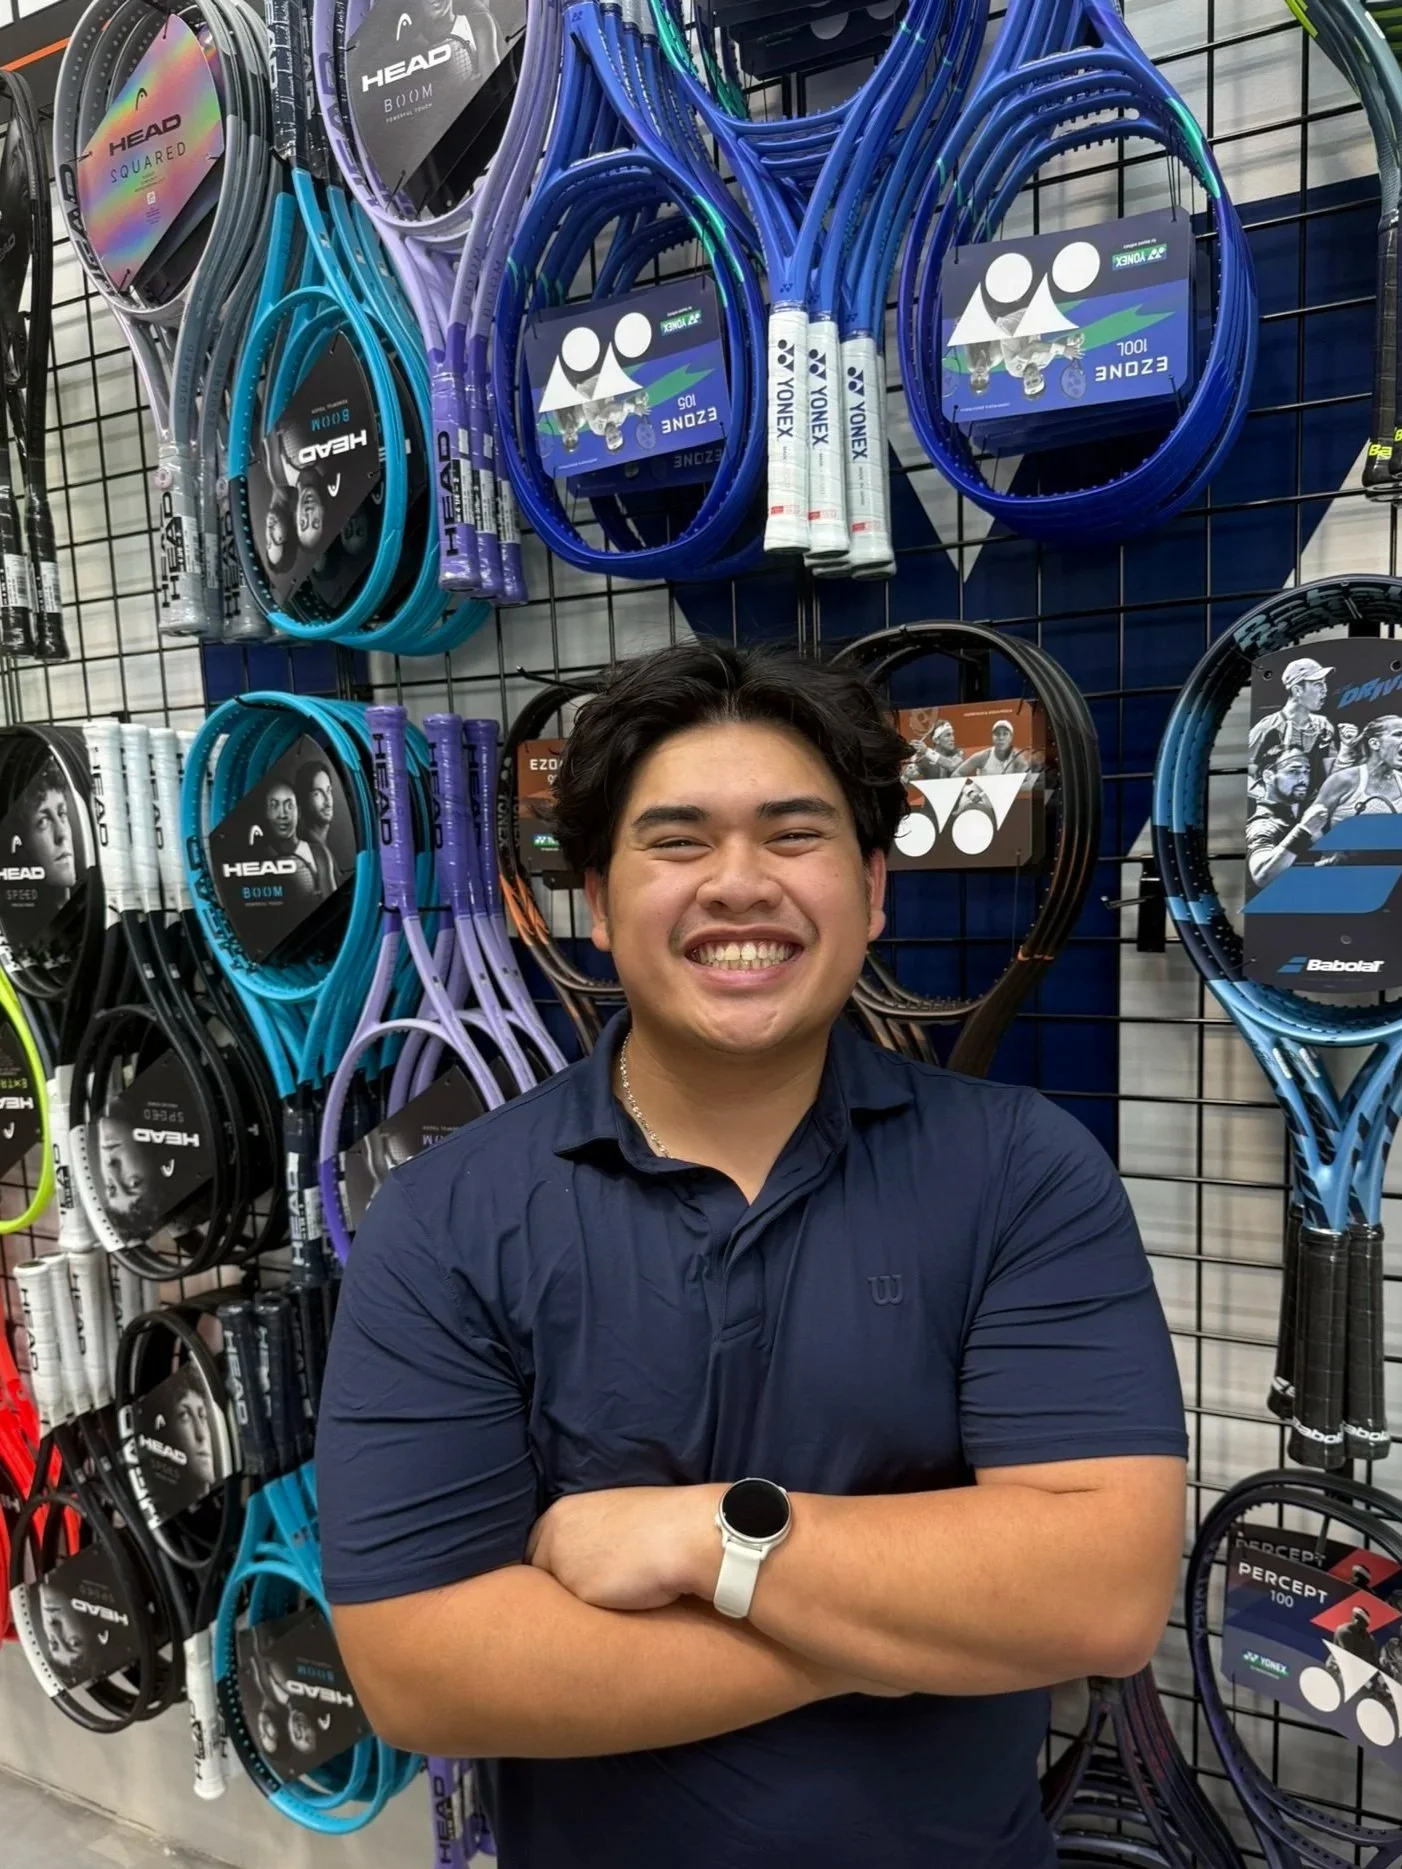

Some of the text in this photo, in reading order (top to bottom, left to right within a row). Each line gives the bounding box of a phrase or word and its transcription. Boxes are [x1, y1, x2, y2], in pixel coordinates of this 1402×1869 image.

[361, 44, 452, 93] HEAD
[384, 83, 434, 114] BOOM
[109, 114, 182, 157] HEAD
[110, 142, 187, 184] SQUARED
[1115, 251, 1146, 268] YONEX
[662, 317, 687, 334] YONEX
[1116, 338, 1148, 356] 100L
[1095, 355, 1169, 382] EZONE
[677, 393, 697, 410] 105
[776, 377, 795, 439] YONEX
[810, 386, 829, 447] YONEX
[311, 408, 350, 432] BOOM
[661, 406, 718, 434] EZONE
[849, 401, 868, 460] YONEX
[298, 429, 368, 464] HEAD
[438, 430, 458, 557] HEAD
[162, 491, 181, 600] HEAD
[529, 758, 563, 771] EZO
[372, 733, 392, 846] HEAD
[222, 859, 298, 878] HEAD
[242, 886, 284, 899] BOOM
[132, 1128, 200, 1147] HEAD
[287, 1170, 305, 1266] HEAD
[71, 1272, 87, 1356] HEAD
[224, 1330, 249, 1425] HEAD
[138, 1434, 187, 1466] HEAD
[1238, 1562, 1329, 1604] PERCEPT
[1270, 1590, 1294, 1607] 100
[71, 1597, 129, 1627] HEAD
[1260, 1656, 1288, 1674] YONEX
[285, 1679, 354, 1708] HEAD
[433, 1776, 452, 1864] HEAD
